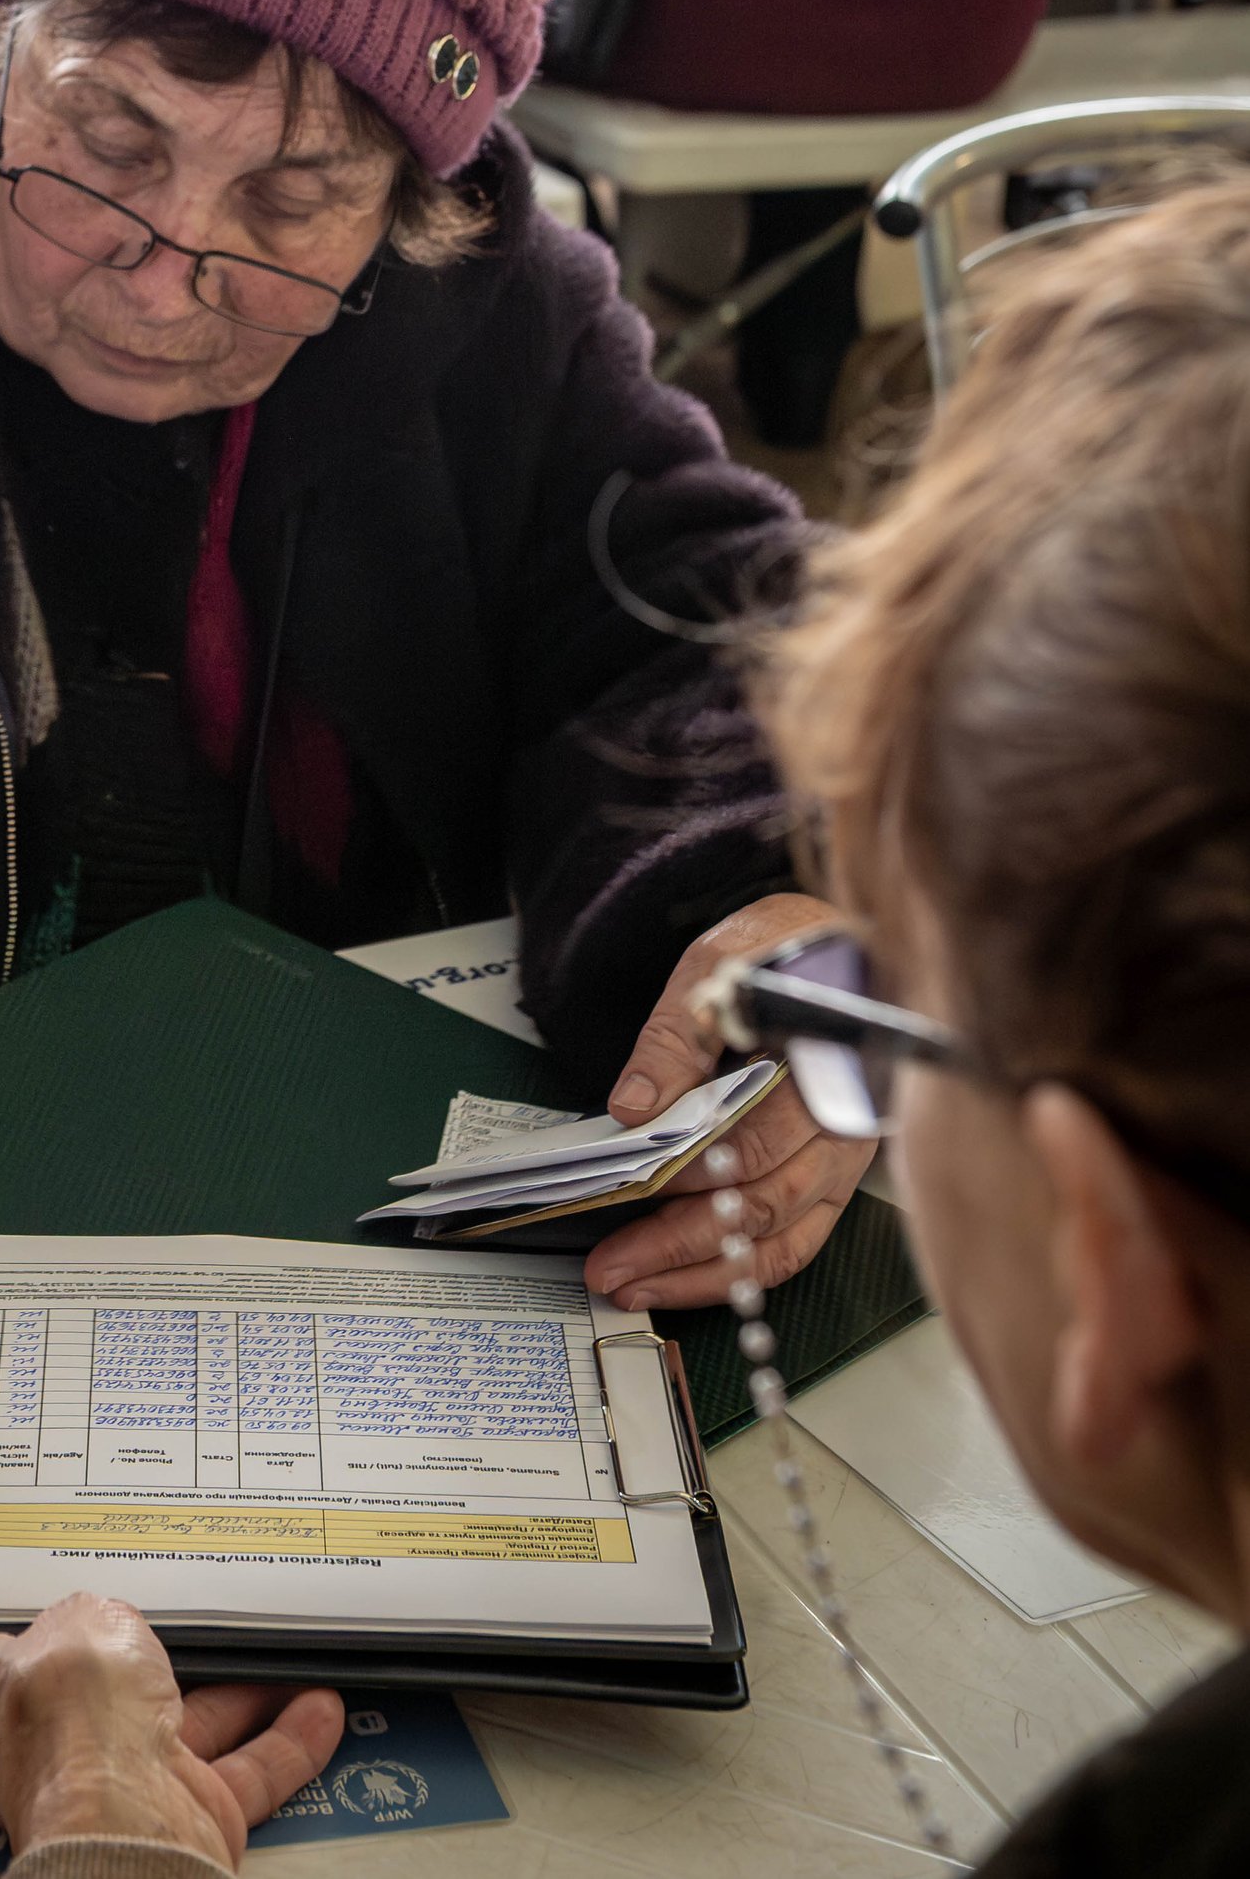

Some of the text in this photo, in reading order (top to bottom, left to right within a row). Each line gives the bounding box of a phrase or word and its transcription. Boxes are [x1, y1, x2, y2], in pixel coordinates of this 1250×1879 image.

[118, 1448, 167, 1456] Телефон
[245, 1451, 316, 1459] народження
[138, 1457, 174, 1465] Phone
[422, 1456, 483, 1464] (повністю)
[406, 1464, 468, 1472] patronymic
[469, 1466, 505, 1474] name,
[507, 1468, 560, 1476] Surname,
[133, 1492, 203, 1500] одержувача
[228, 1493, 296, 1502] інформація
[298, 1496, 353, 1505] Детальна
[361, 1498, 401, 1506] Details
[403, 1499, 466, 1508] Beneficiary
[529, 1517, 592, 1526] Date/Дата:
[537, 1526, 593, 1534] Employee
[478, 1534, 546, 1542] (населений
[549, 1534, 595, 1543] Локація
[94, 1551, 274, 1564] form/Реєстраційний
[461, 1550, 500, 1558] Номер
[510, 1552, 554, 1560] number
[557, 1552, 598, 1561] Project
[280, 1556, 382, 1568] Registration
[373, 1807, 414, 1823] WFP
